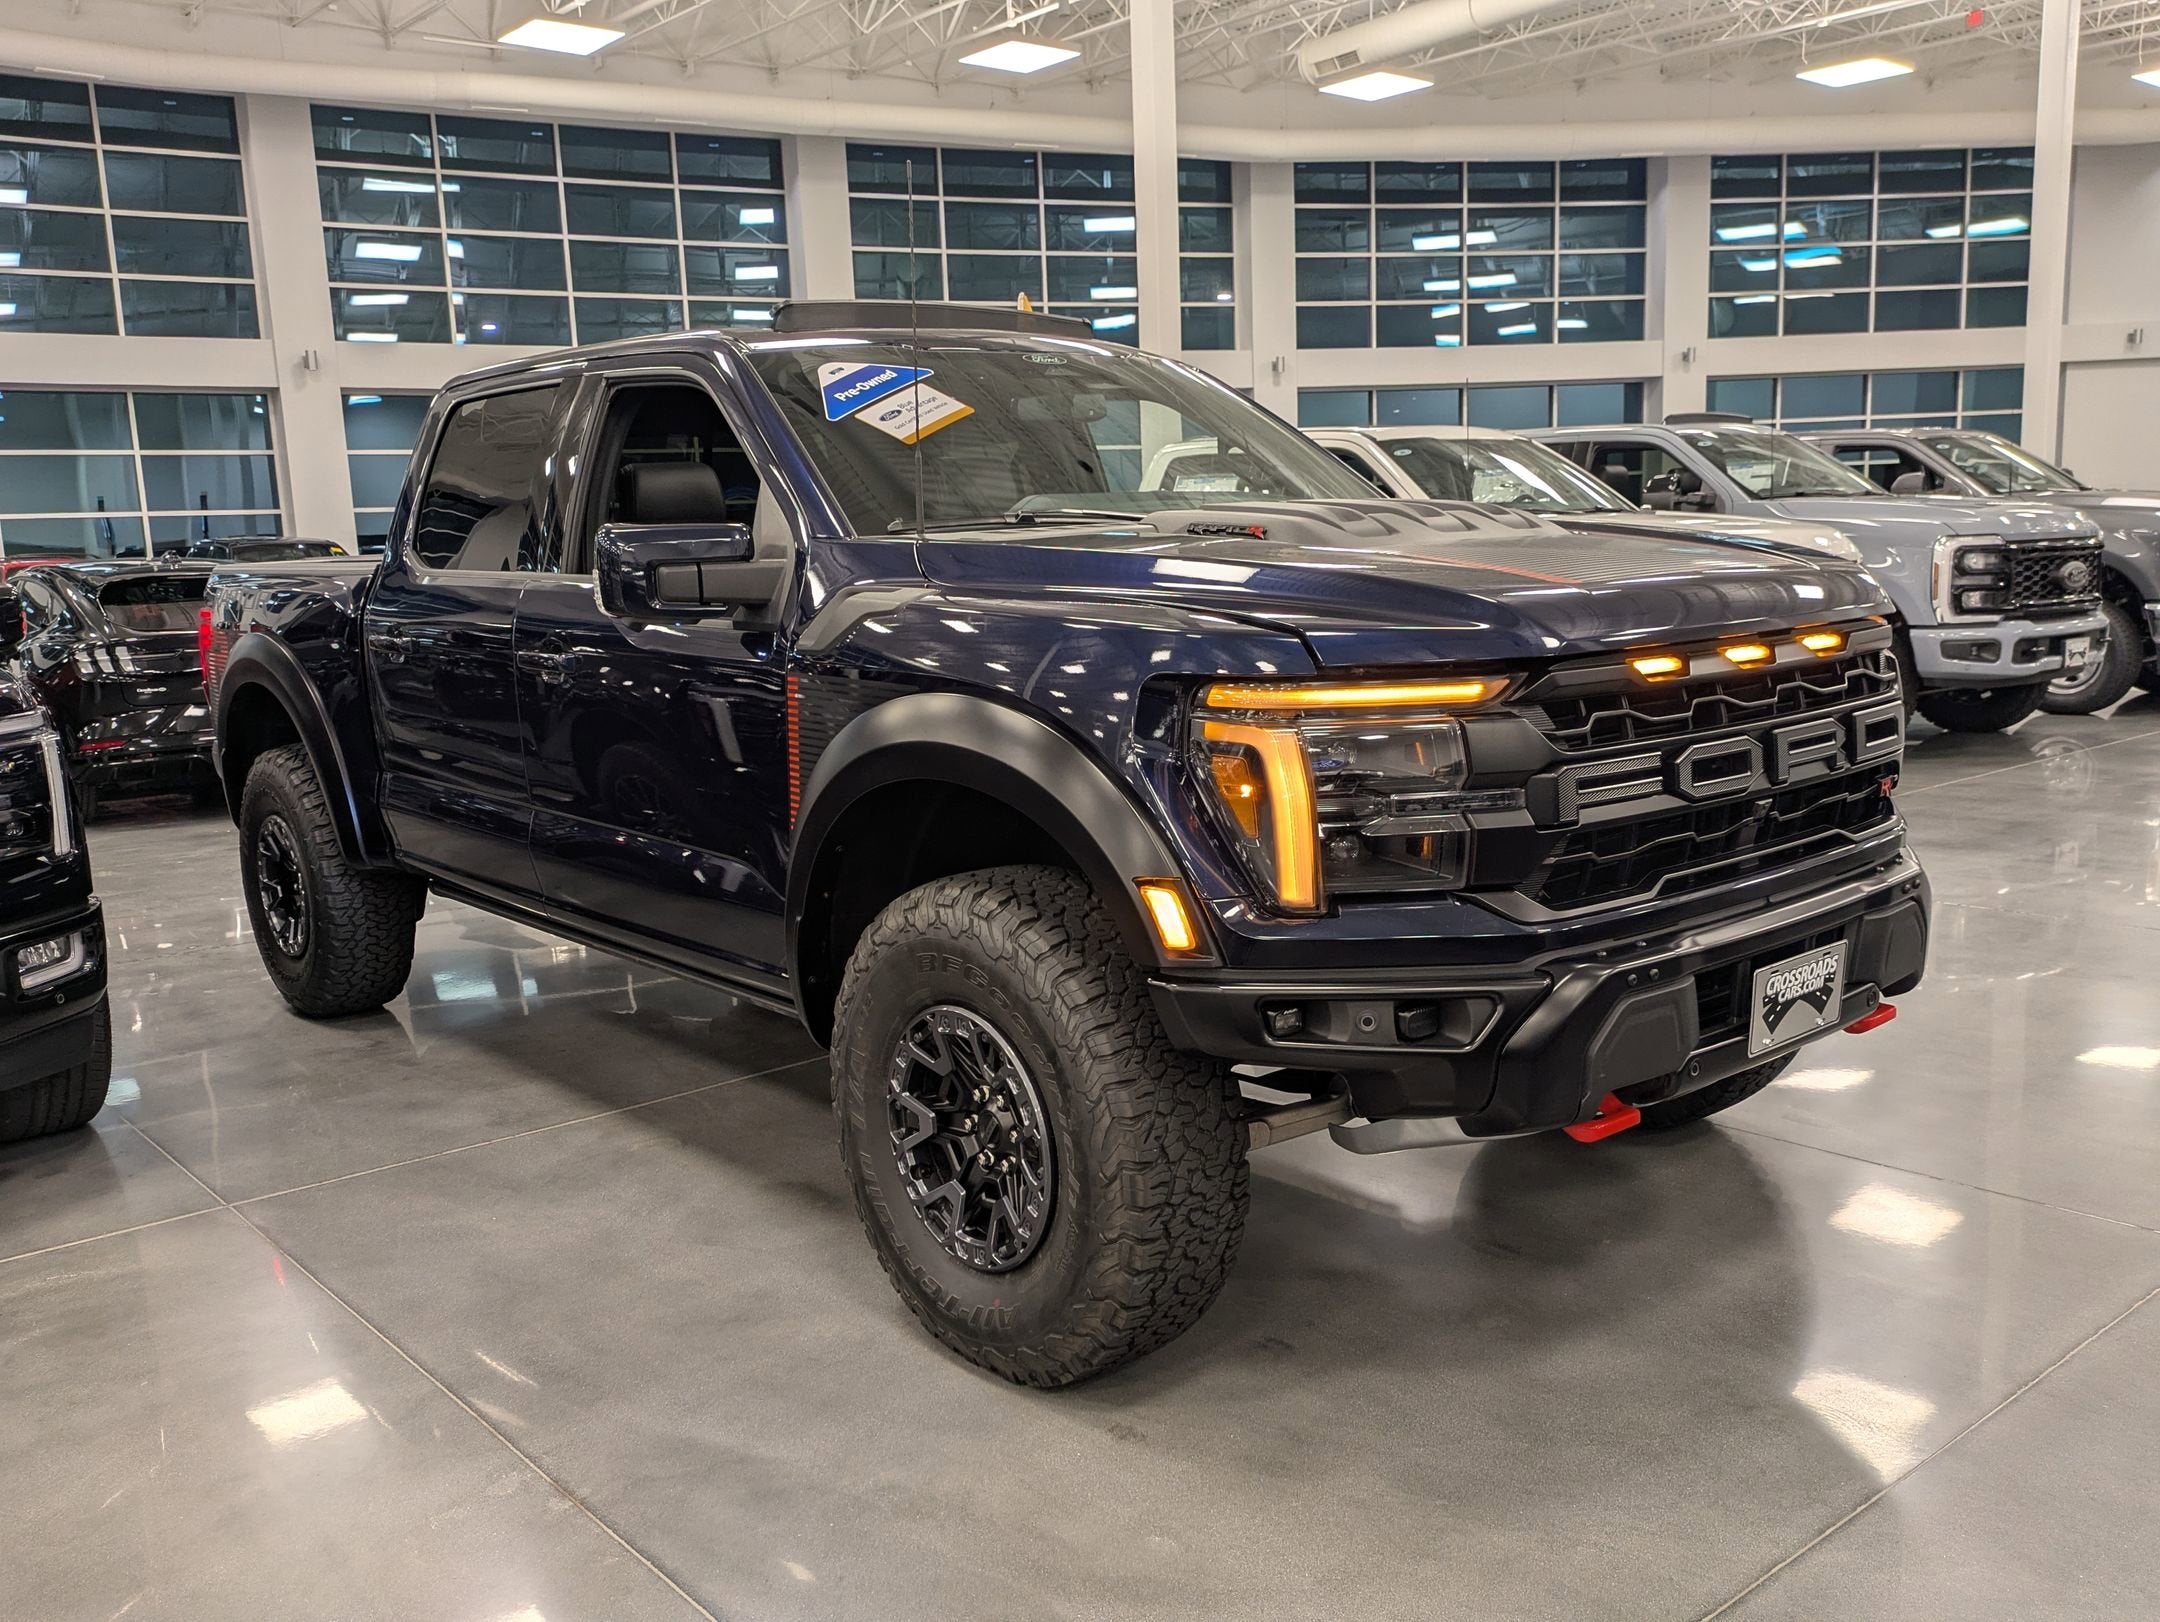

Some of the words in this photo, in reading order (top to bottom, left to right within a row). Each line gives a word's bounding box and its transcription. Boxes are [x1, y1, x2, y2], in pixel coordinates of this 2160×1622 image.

[833, 369, 899, 402] Pre-Owned
[1552, 700, 1905, 823] FORD
[1766, 954, 1840, 997] CROSSROADS
[1778, 975, 1826, 1003] CARS.COM
